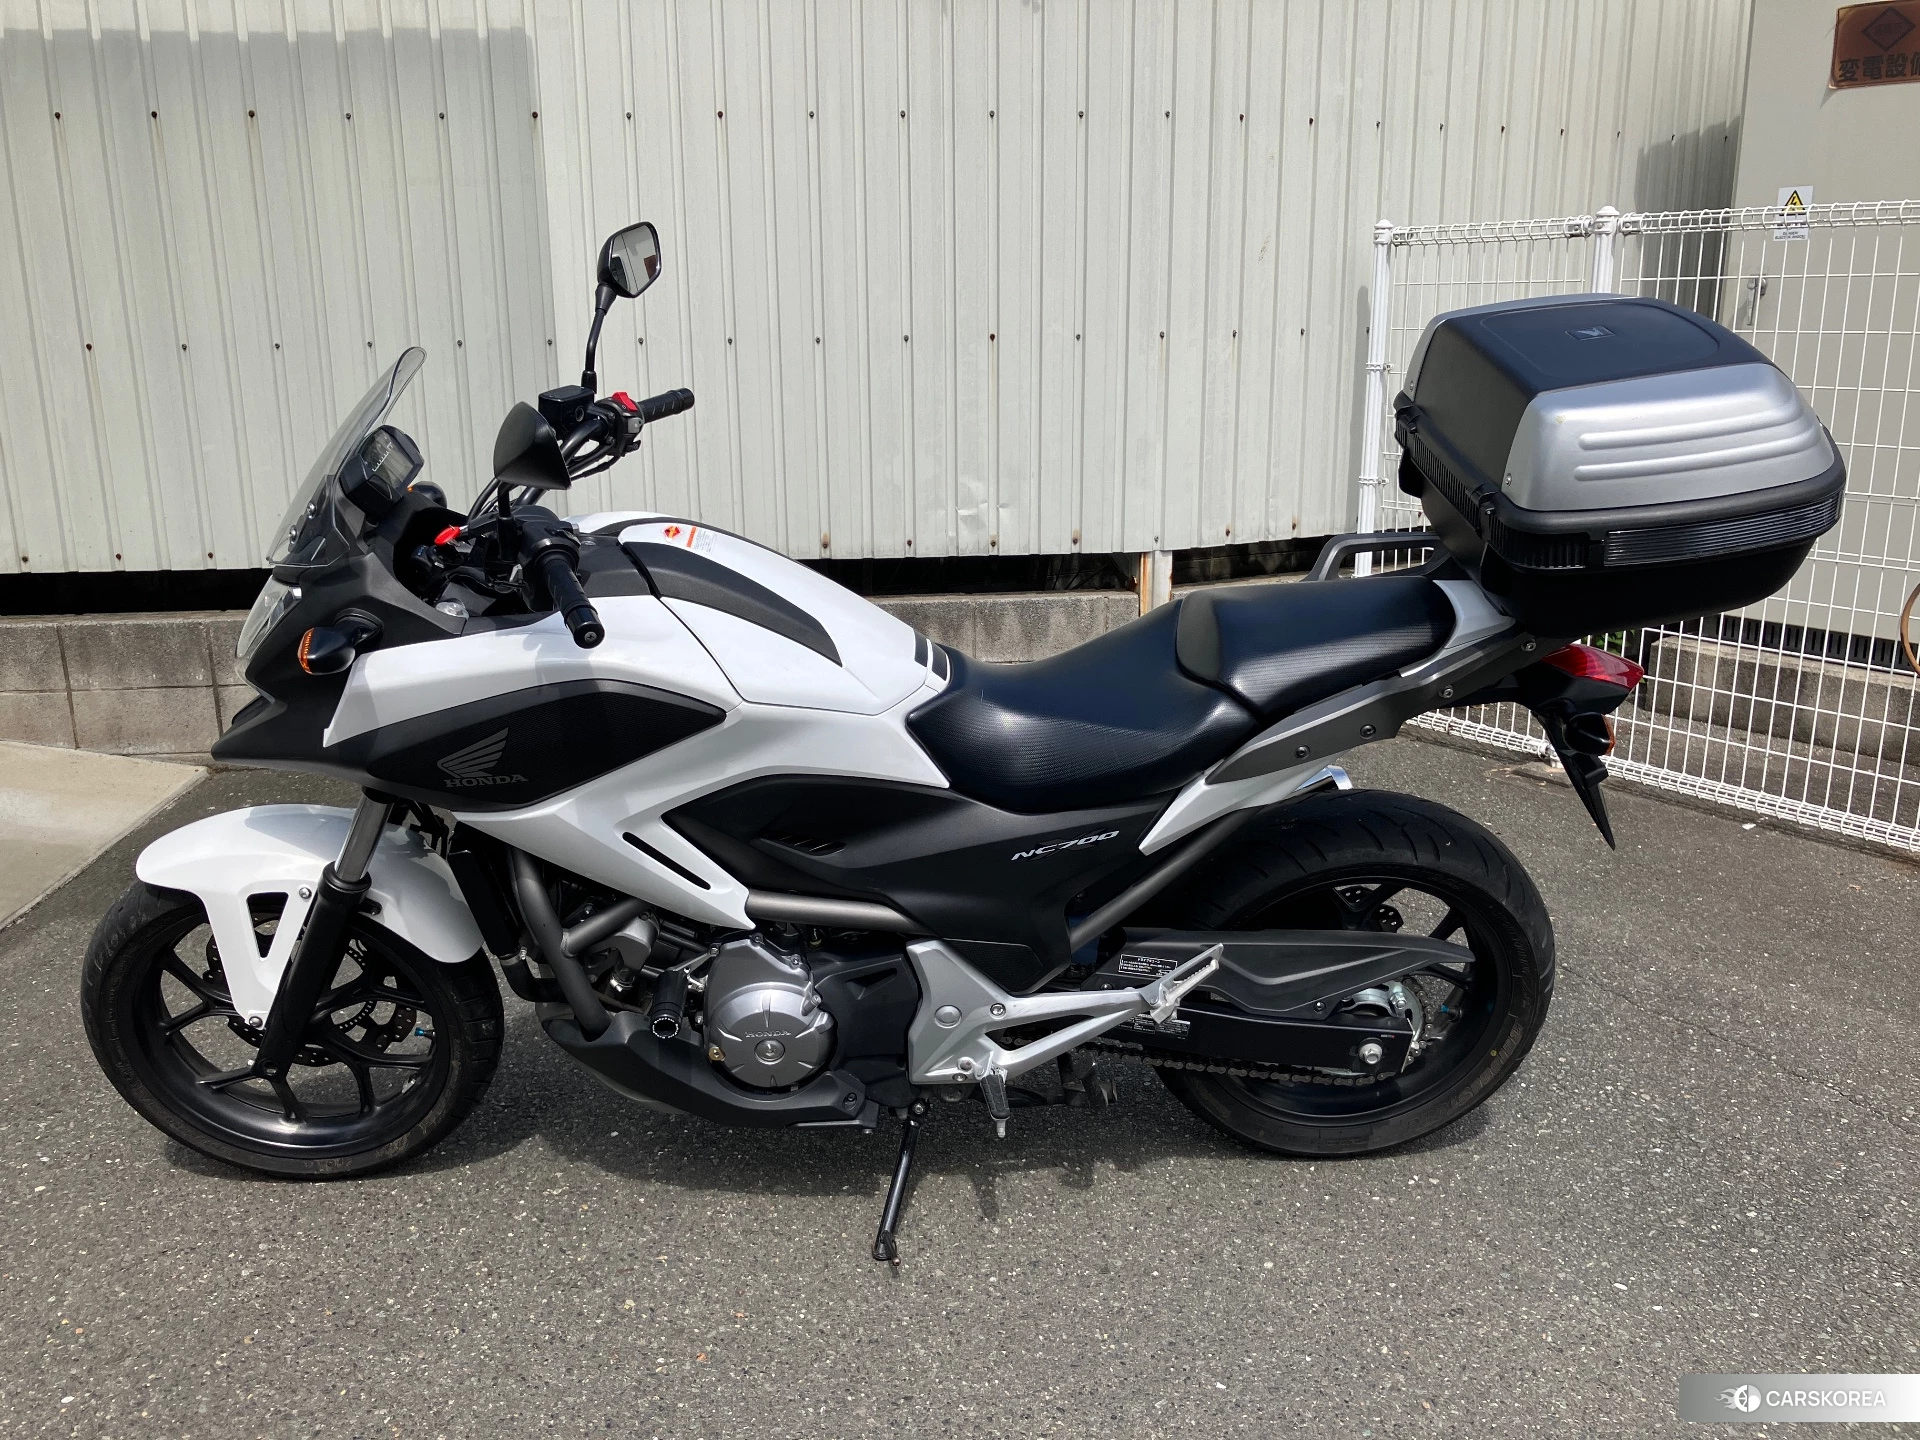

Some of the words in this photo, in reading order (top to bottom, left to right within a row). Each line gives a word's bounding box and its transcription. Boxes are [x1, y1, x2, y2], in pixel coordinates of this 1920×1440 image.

[444, 774, 529, 788] HONDA
[1011, 830, 1120, 861] NC700
[745, 1030, 792, 1038] HONDA
